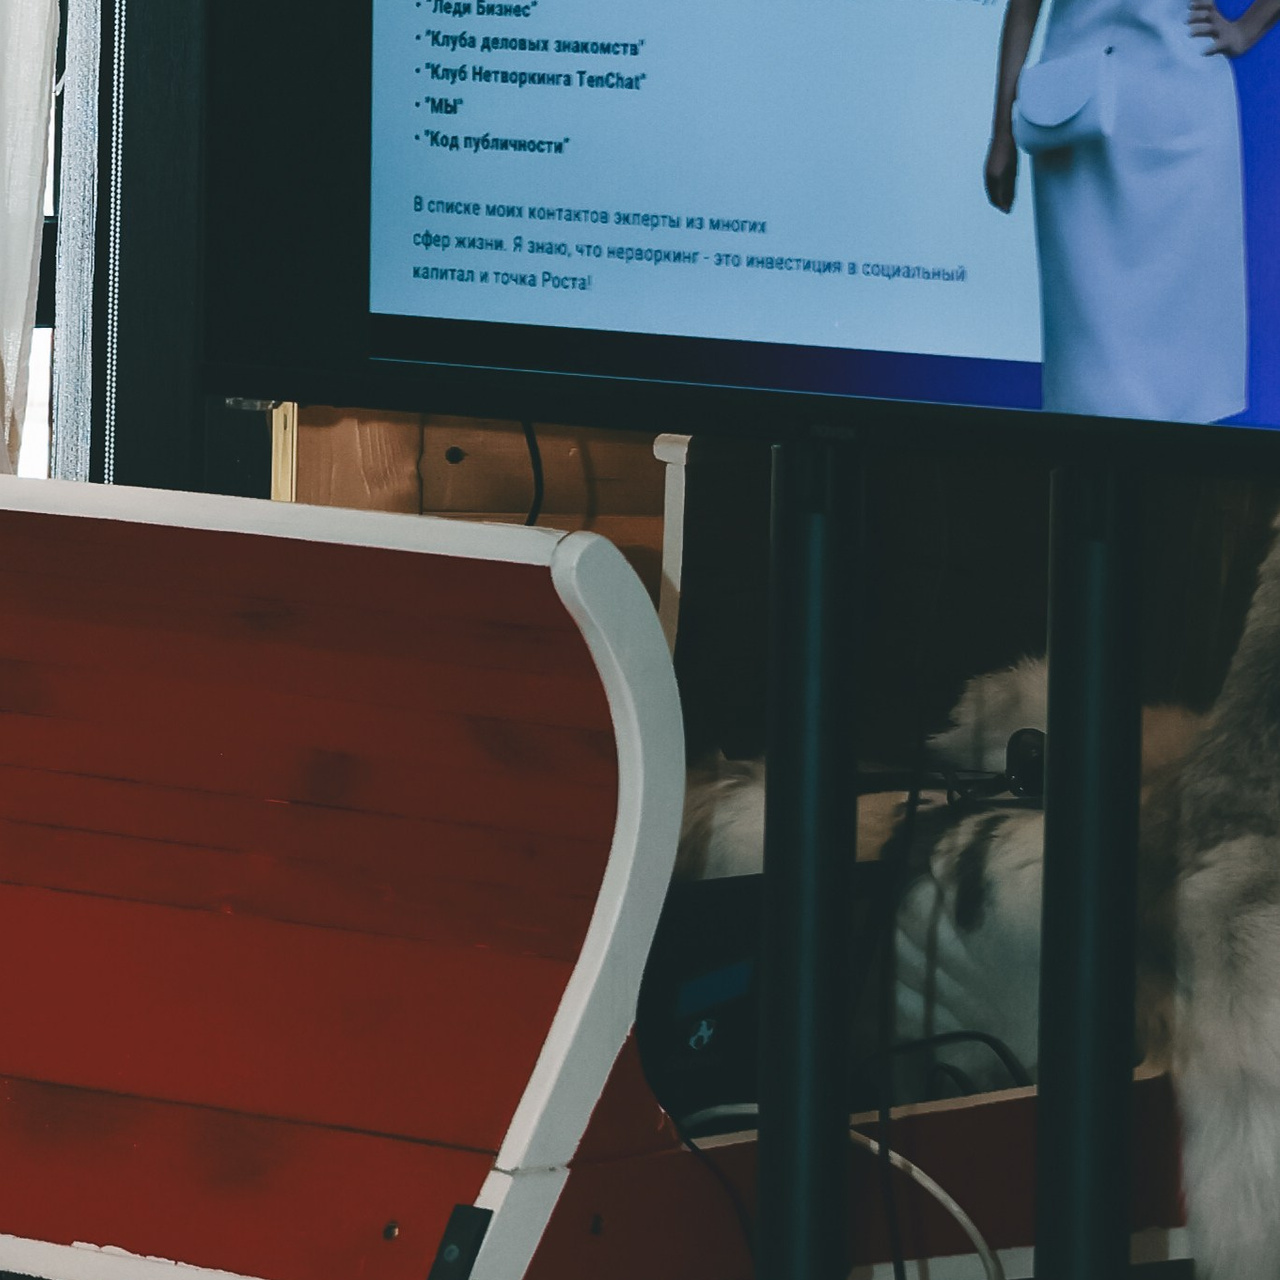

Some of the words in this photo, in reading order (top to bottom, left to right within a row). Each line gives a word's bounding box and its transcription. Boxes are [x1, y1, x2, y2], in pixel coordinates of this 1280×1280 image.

[476, 0, 538, 17] Бизнес"
[425, 29, 477, 51] "Клуба
[480, 35, 549, 53] деловых
[554, 39, 645, 56] знакомств"
[425, 62, 468, 84] "Клуб
[472, 66, 571, 88] Нетворкинга
[576, 70, 646, 90] TenChat"
[425, 96, 463, 114] "МЫ"
[424, 129, 459, 150] "Код
[464, 133, 570, 153] публичности"
[414, 195, 423, 212] В
[427, 198, 481, 216] списке
[485, 204, 523, 218] моих
[528, 204, 609, 224] контактов
[686, 215, 704, 230] из
[709, 218, 766, 234] многих
[413, 229, 450, 250] сфер
[454, 235, 507, 252] жизни.
[513, 235, 523, 253] Я
[527, 240, 572, 258] знаю,
[575, 244, 602, 258] что
[714, 253, 741, 267] это
[746, 255, 842, 274] инвестиция
[848, 263, 856, 275] в
[862, 261, 967, 282] социальный
[412, 266, 475, 282] капитал
[480, 272, 489, 283] и
[494, 271, 536, 287] точка
[542, 271, 592, 290] Роста!
